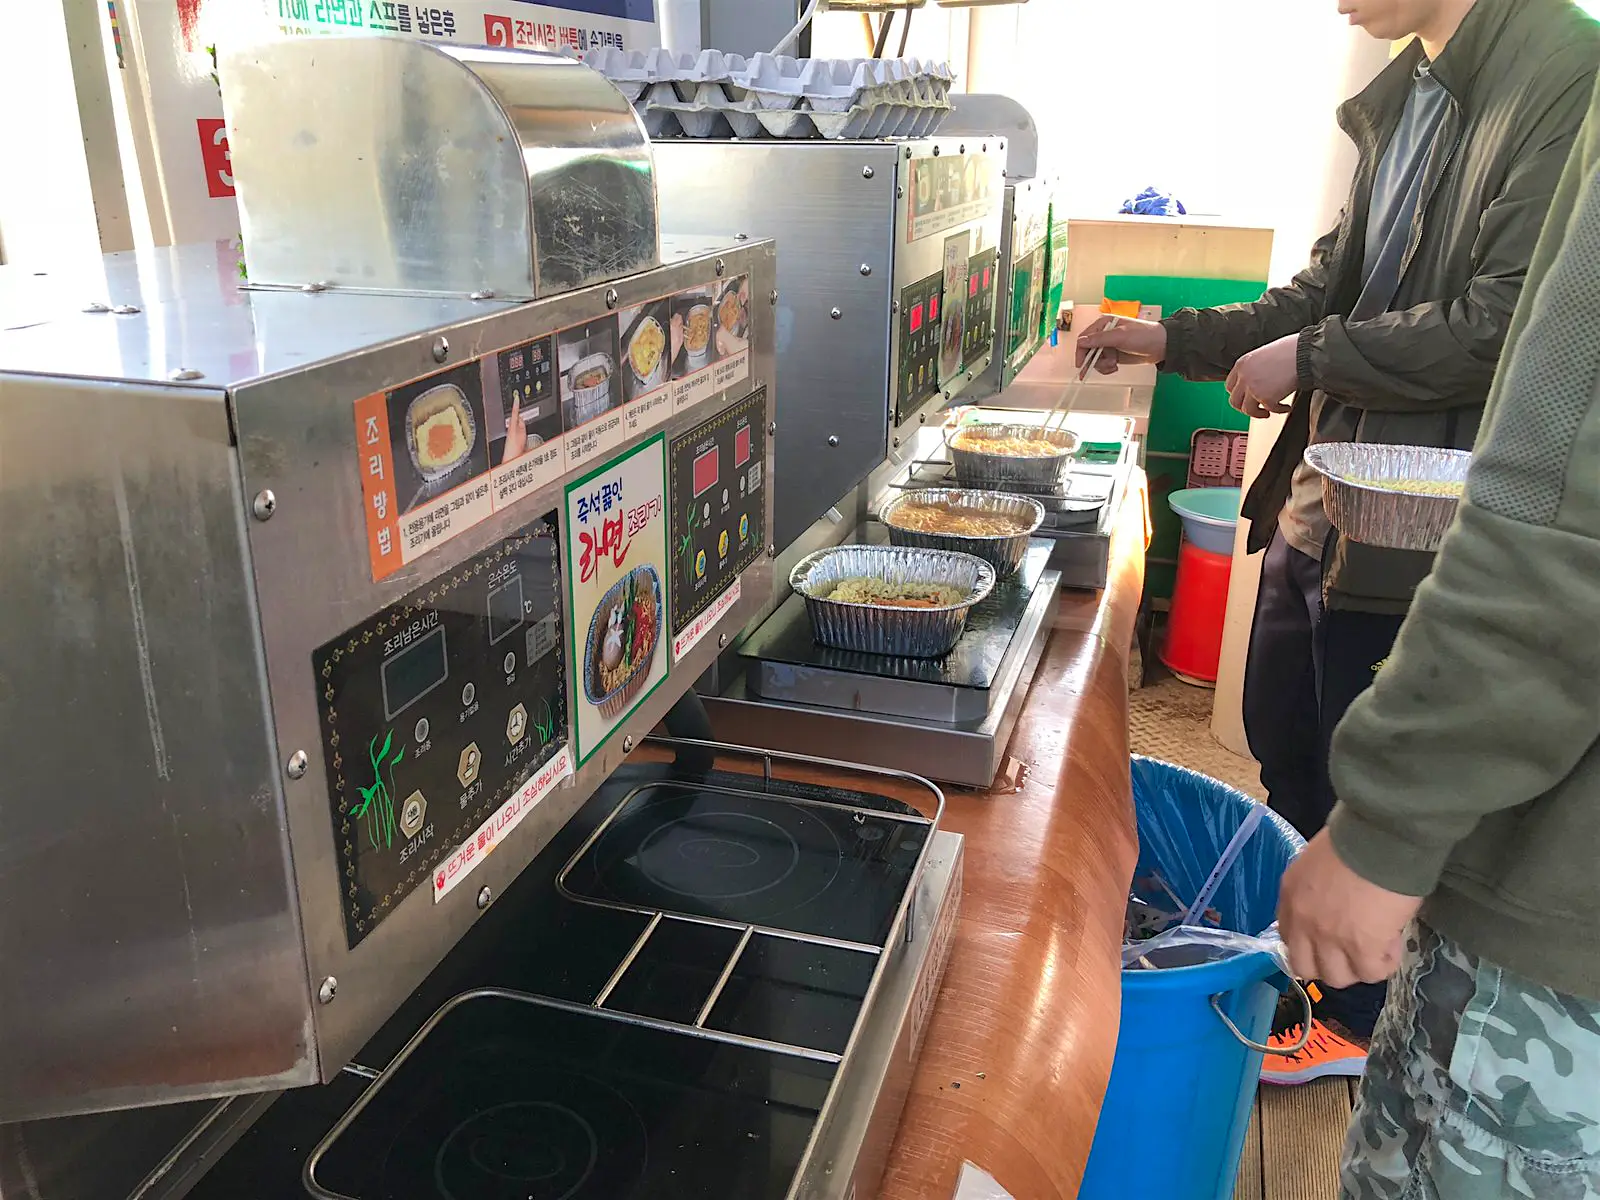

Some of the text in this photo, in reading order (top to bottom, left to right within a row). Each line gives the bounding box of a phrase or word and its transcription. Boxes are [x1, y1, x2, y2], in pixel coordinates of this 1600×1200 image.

[370, 1, 412, 32] 스프를
[415, 6, 456, 37] 넣은후
[515, 20, 556, 46] 조리시작
[559, 26, 588, 50] 버튼에
[628, 495, 661, 537] 조리기
[579, 509, 631, 588] 라면
[383, 610, 439, 656] 조리남은시간
[504, 735, 532, 767] 시간추가
[460, 780, 483, 810] 물추가
[400, 823, 435, 864] 조리시작
[448, 842, 475, 879] 뜨거운
[477, 826, 495, 850] 물이
[497, 797, 521, 831] 나오니
